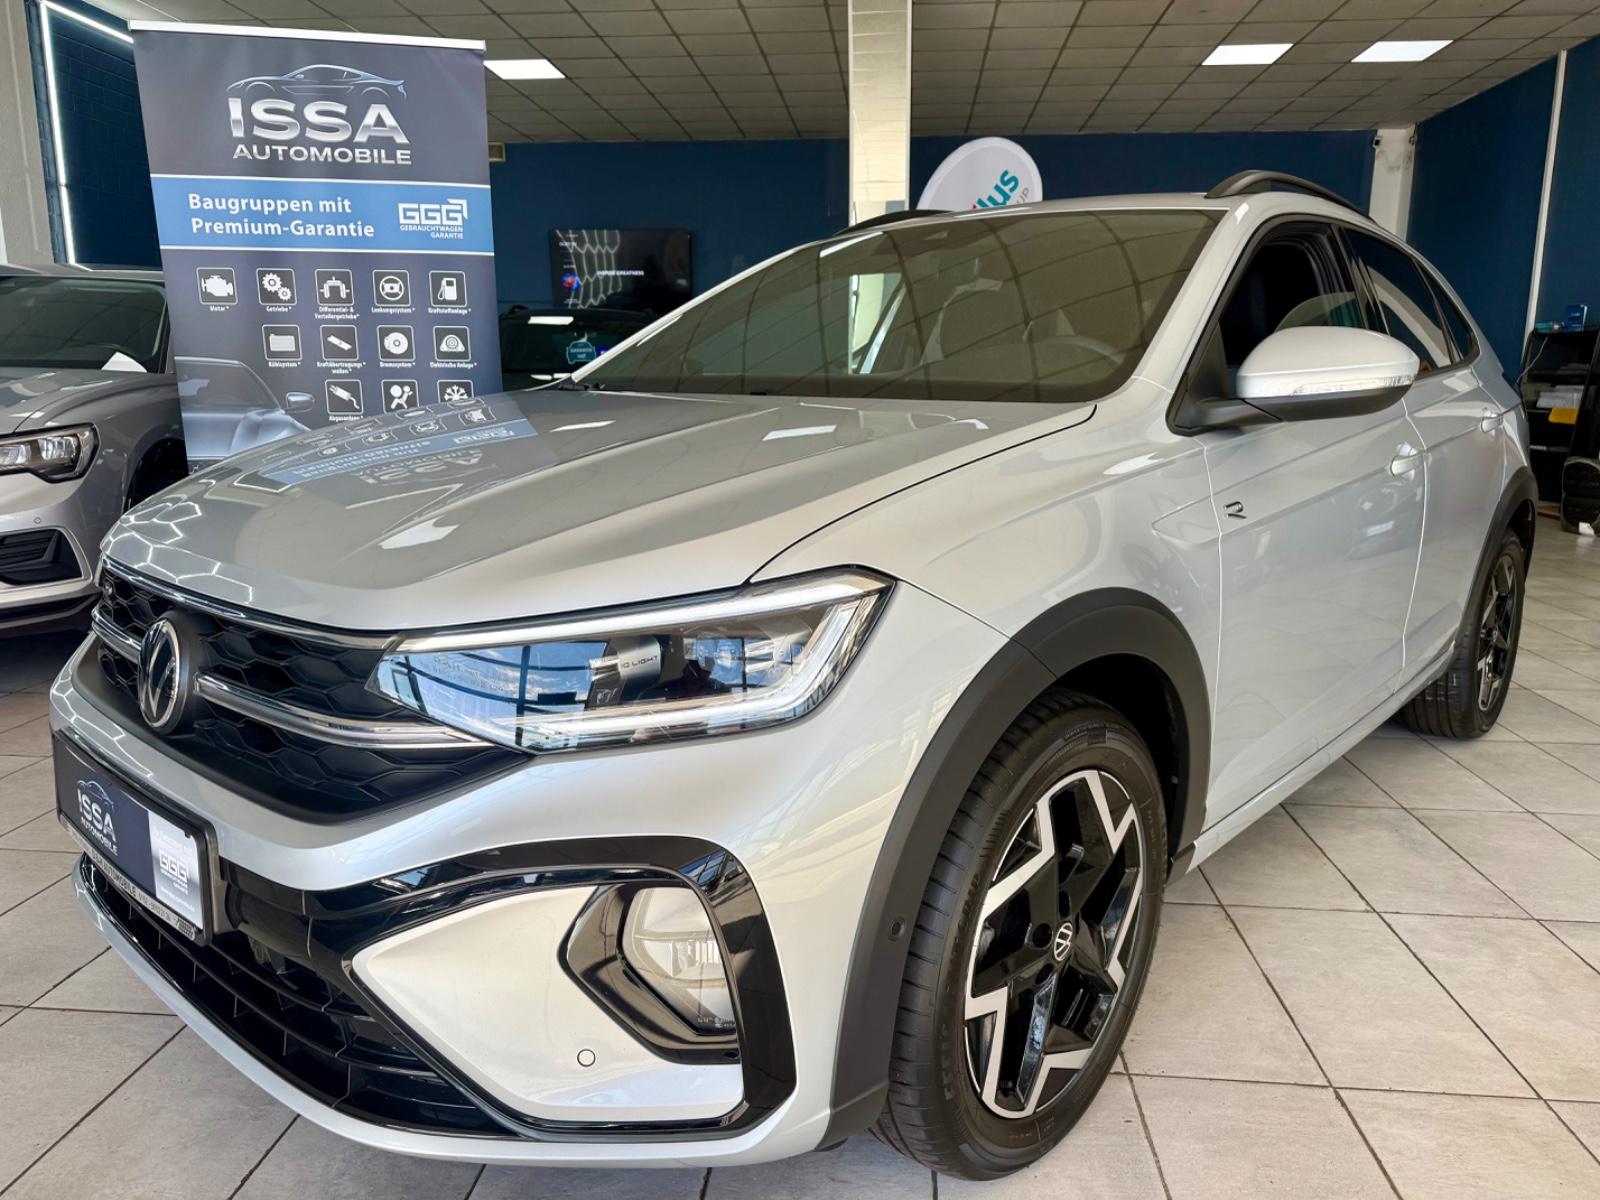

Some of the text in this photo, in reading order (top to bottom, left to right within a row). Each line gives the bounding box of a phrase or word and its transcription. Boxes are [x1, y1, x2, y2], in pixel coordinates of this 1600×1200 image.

[228, 97, 410, 144] ISSA
[232, 143, 412, 165] AUTOMOBILE
[188, 193, 352, 215] Baugruppen mit
[398, 198, 468, 225] GGG
[191, 218, 375, 237] Premium-Garantie
[400, 224, 464, 232] GEBRAUCHTWAGEN
[430, 231, 464, 239] GARANTIE
[77, 788, 117, 843] ISSA
[81, 815, 118, 857] AUTOMOBILE
